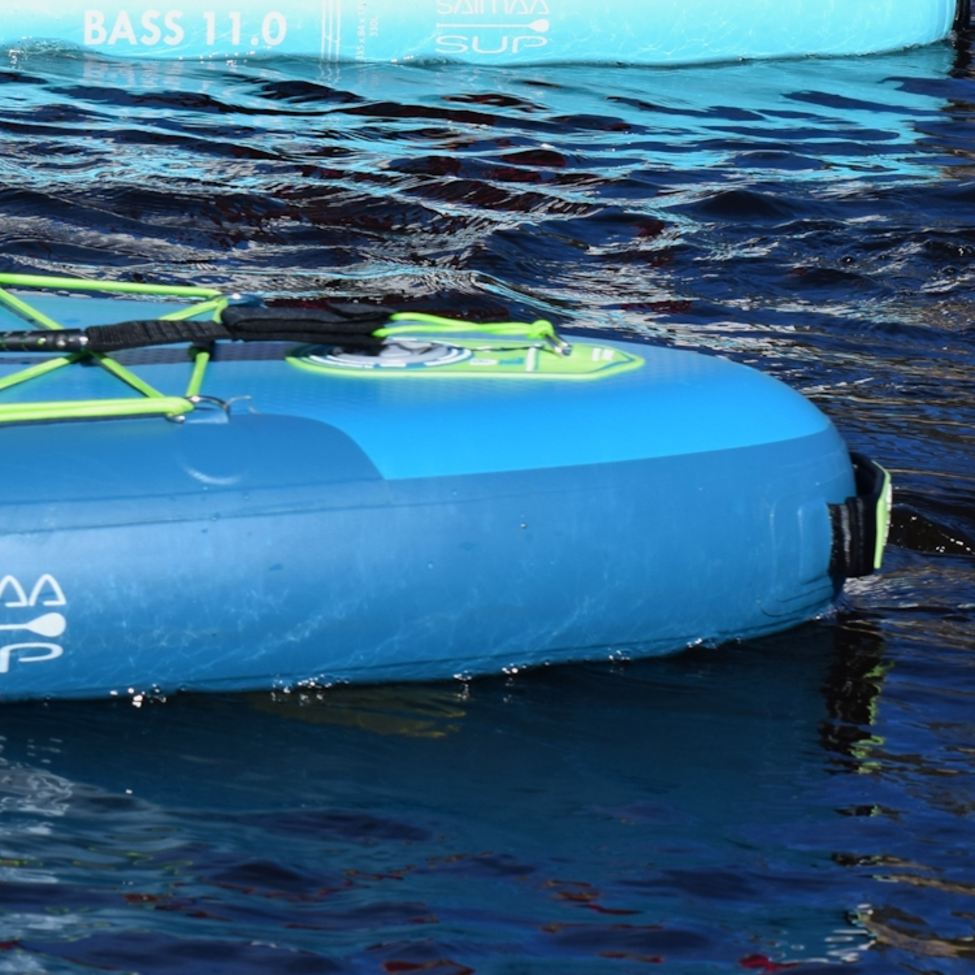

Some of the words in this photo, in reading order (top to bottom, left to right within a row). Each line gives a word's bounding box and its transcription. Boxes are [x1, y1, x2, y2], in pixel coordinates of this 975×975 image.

[83, 9, 185, 46] BASS
[202, 10, 288, 46] 11.0
[434, 34, 549, 55] SUP
